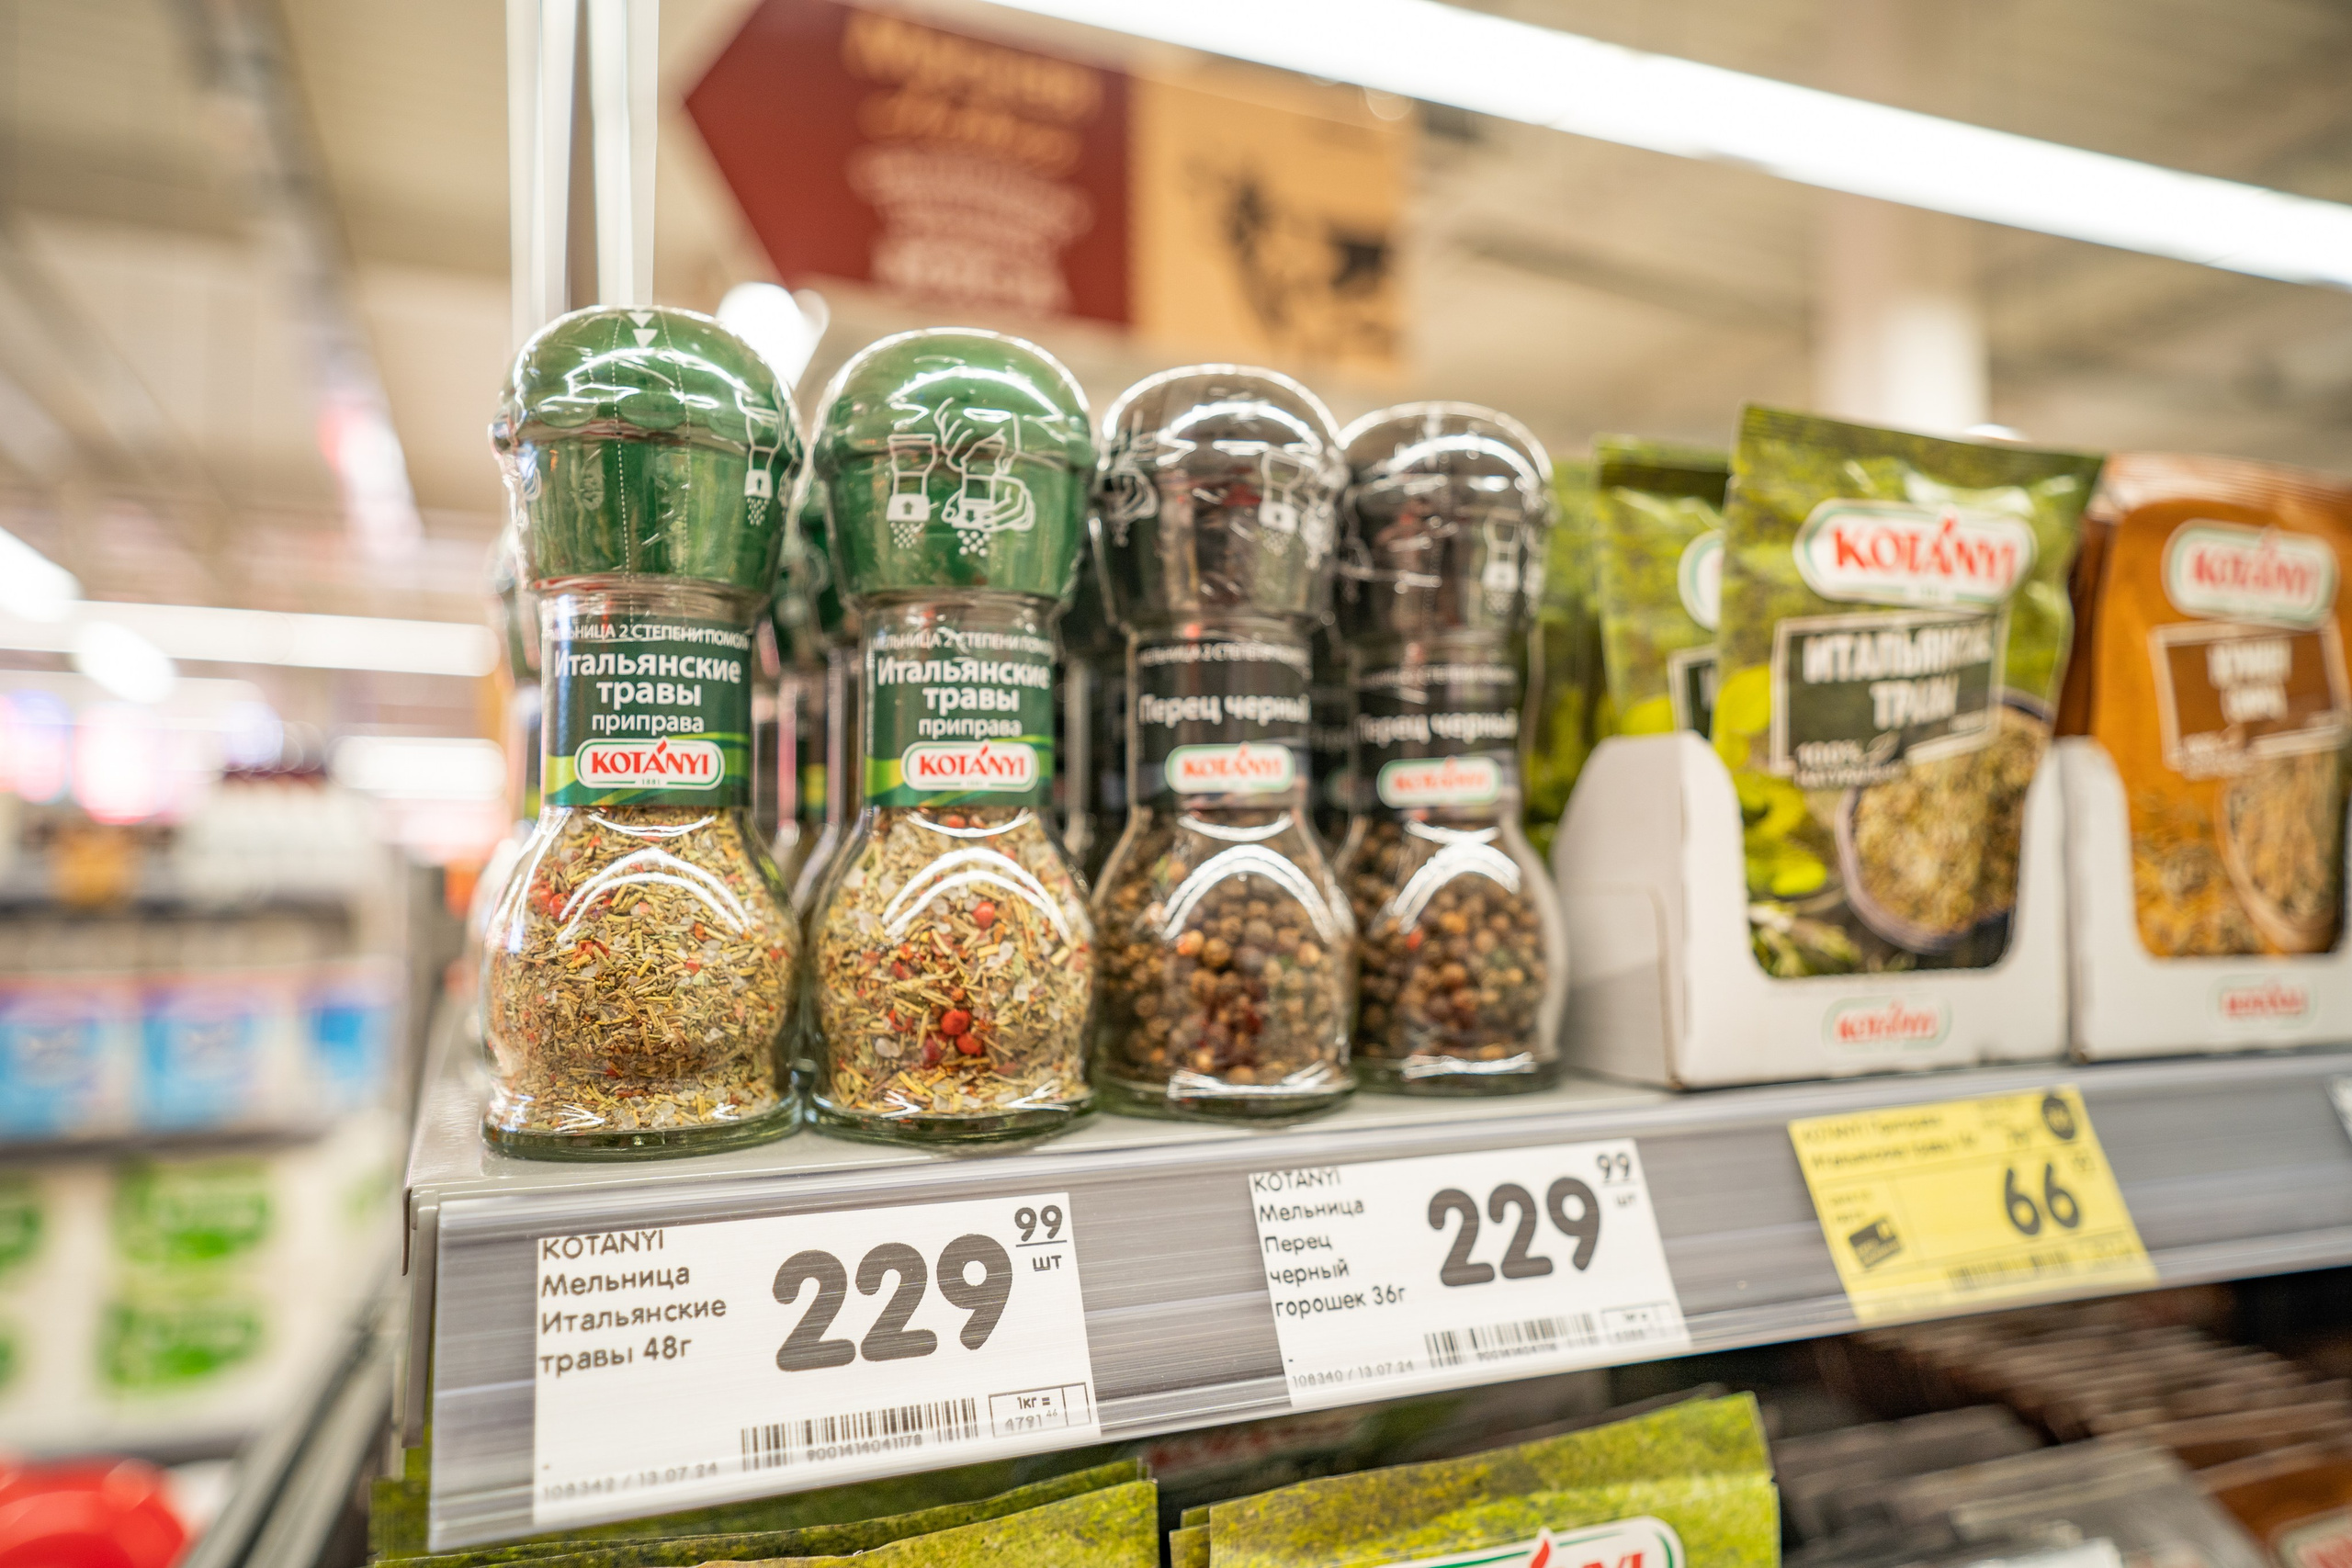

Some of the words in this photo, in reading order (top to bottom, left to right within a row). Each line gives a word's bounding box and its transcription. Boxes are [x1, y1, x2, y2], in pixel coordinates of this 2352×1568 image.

[619, 624, 628, 637] 2
[555, 650, 742, 683] Итальянские
[877, 656, 1051, 689] Итальянские
[596, 682, 701, 710] травы
[922, 687, 1019, 716] травы
[1138, 694, 1222, 728] Перец
[592, 715, 705, 736] приправа
[919, 718, 1023, 739] приправа
[1253, 1168, 1341, 1192] KOTANYI
[1597, 1153, 1630, 1179] 99
[1259, 1197, 1364, 1223] Мельница
[2004, 1161, 2080, 1236] 66
[1014, 1204, 1063, 1242] 99
[1428, 1177, 1600, 1286] 229
[542, 1229, 663, 1259] KOTANYI
[1265, 1233, 1332, 1256] Перец
[1033, 1255, 1062, 1271] шт
[1271, 1258, 1349, 1288] черный
[541, 1267, 690, 1297] Мельница
[542, 1299, 727, 1334] Итальянские
[772, 1234, 1012, 1371] 229
[1275, 1290, 1366, 1319] горошек
[1373, 1285, 1407, 1306] 36г
[539, 1346, 633, 1378] травы
[642, 1335, 693, 1361] 48г
[1017, 1396, 1037, 1410] 1кг
